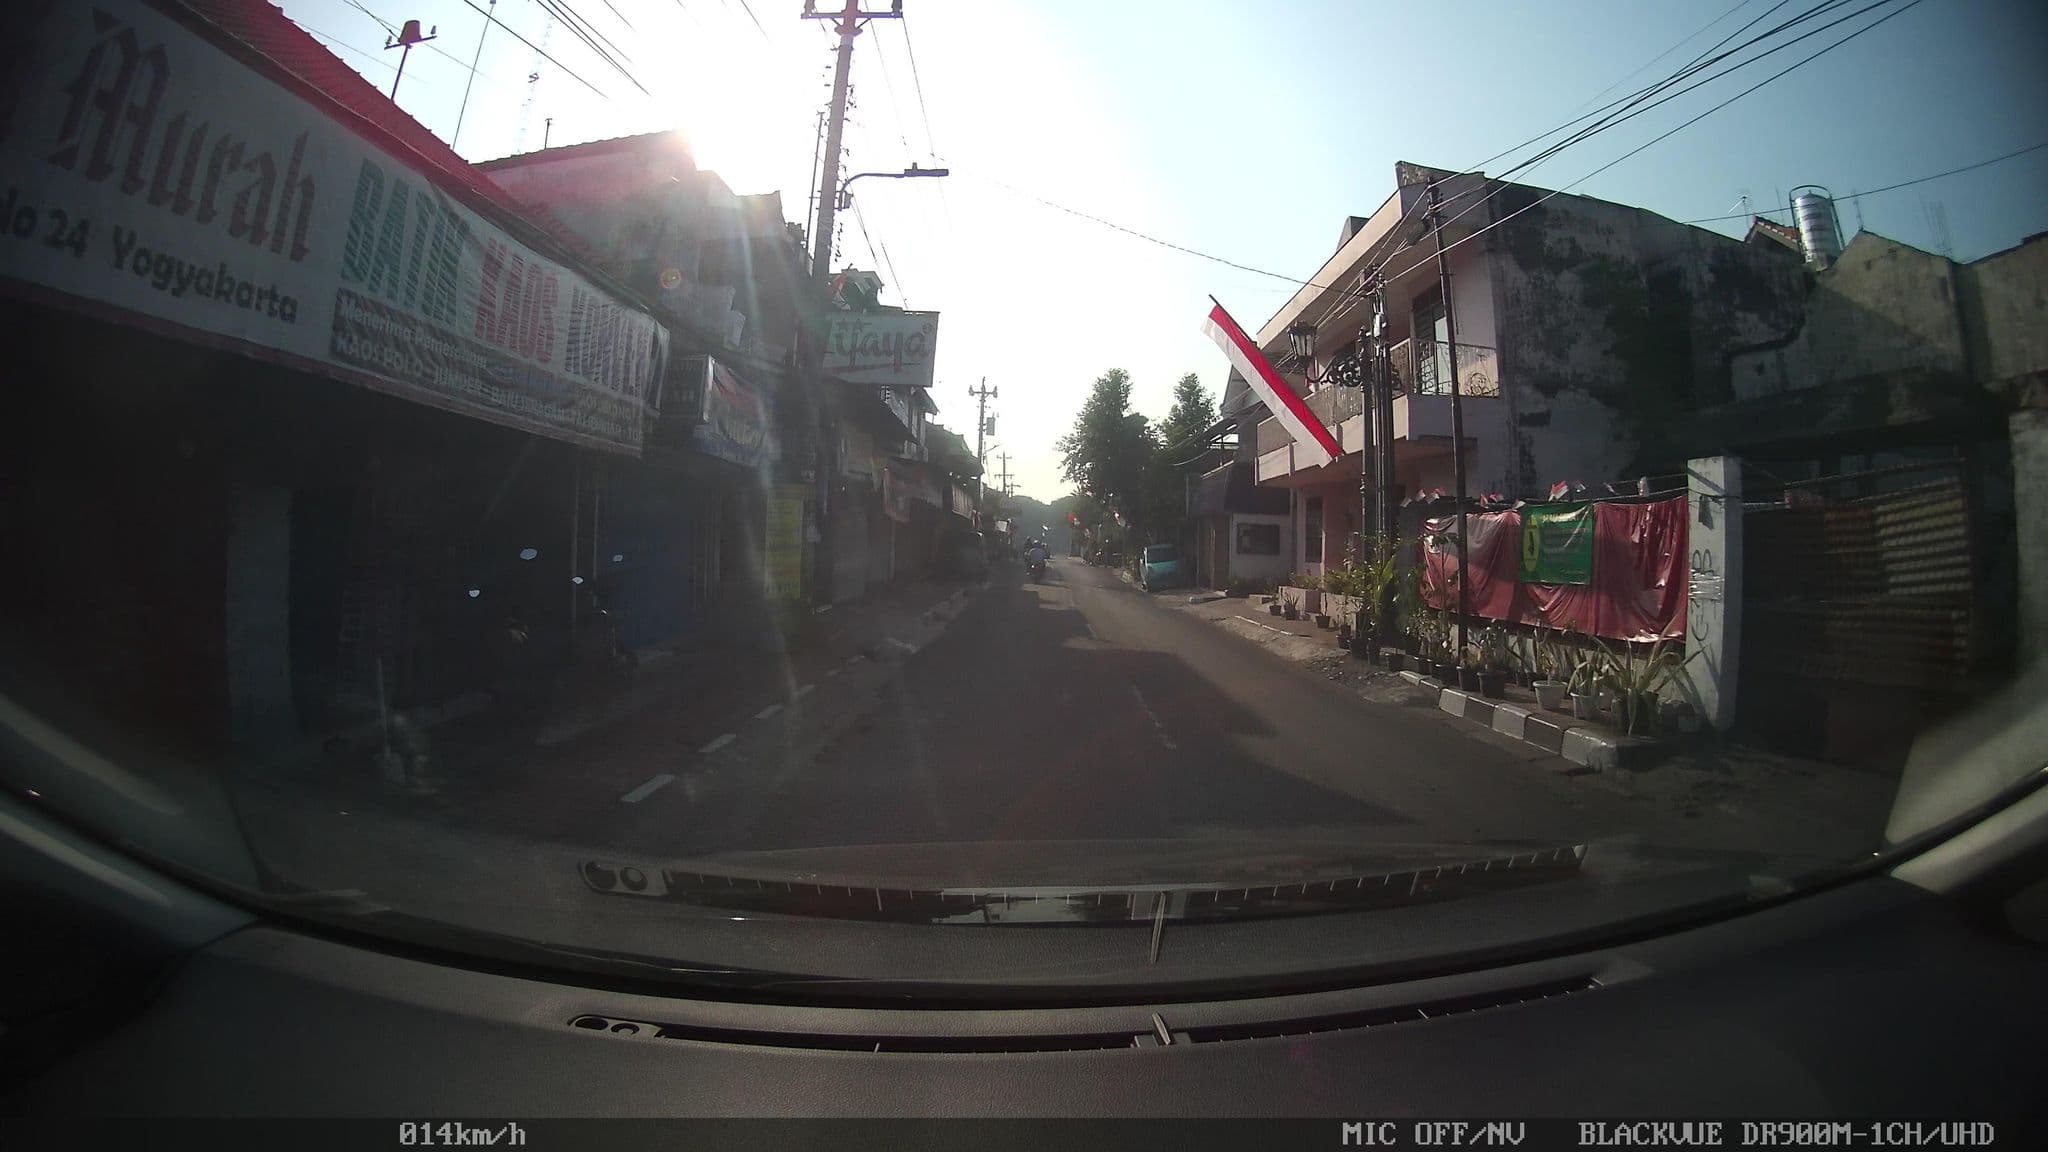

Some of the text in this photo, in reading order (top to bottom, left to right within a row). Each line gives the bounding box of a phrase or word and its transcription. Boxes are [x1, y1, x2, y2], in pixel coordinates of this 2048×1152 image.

[47, 6, 315, 262] Murah
[44, 208, 91, 258] 24
[110, 224, 299, 324] Yogyakarta
[340, 156, 470, 330] BATIK
[475, 235, 561, 365] KAOS
